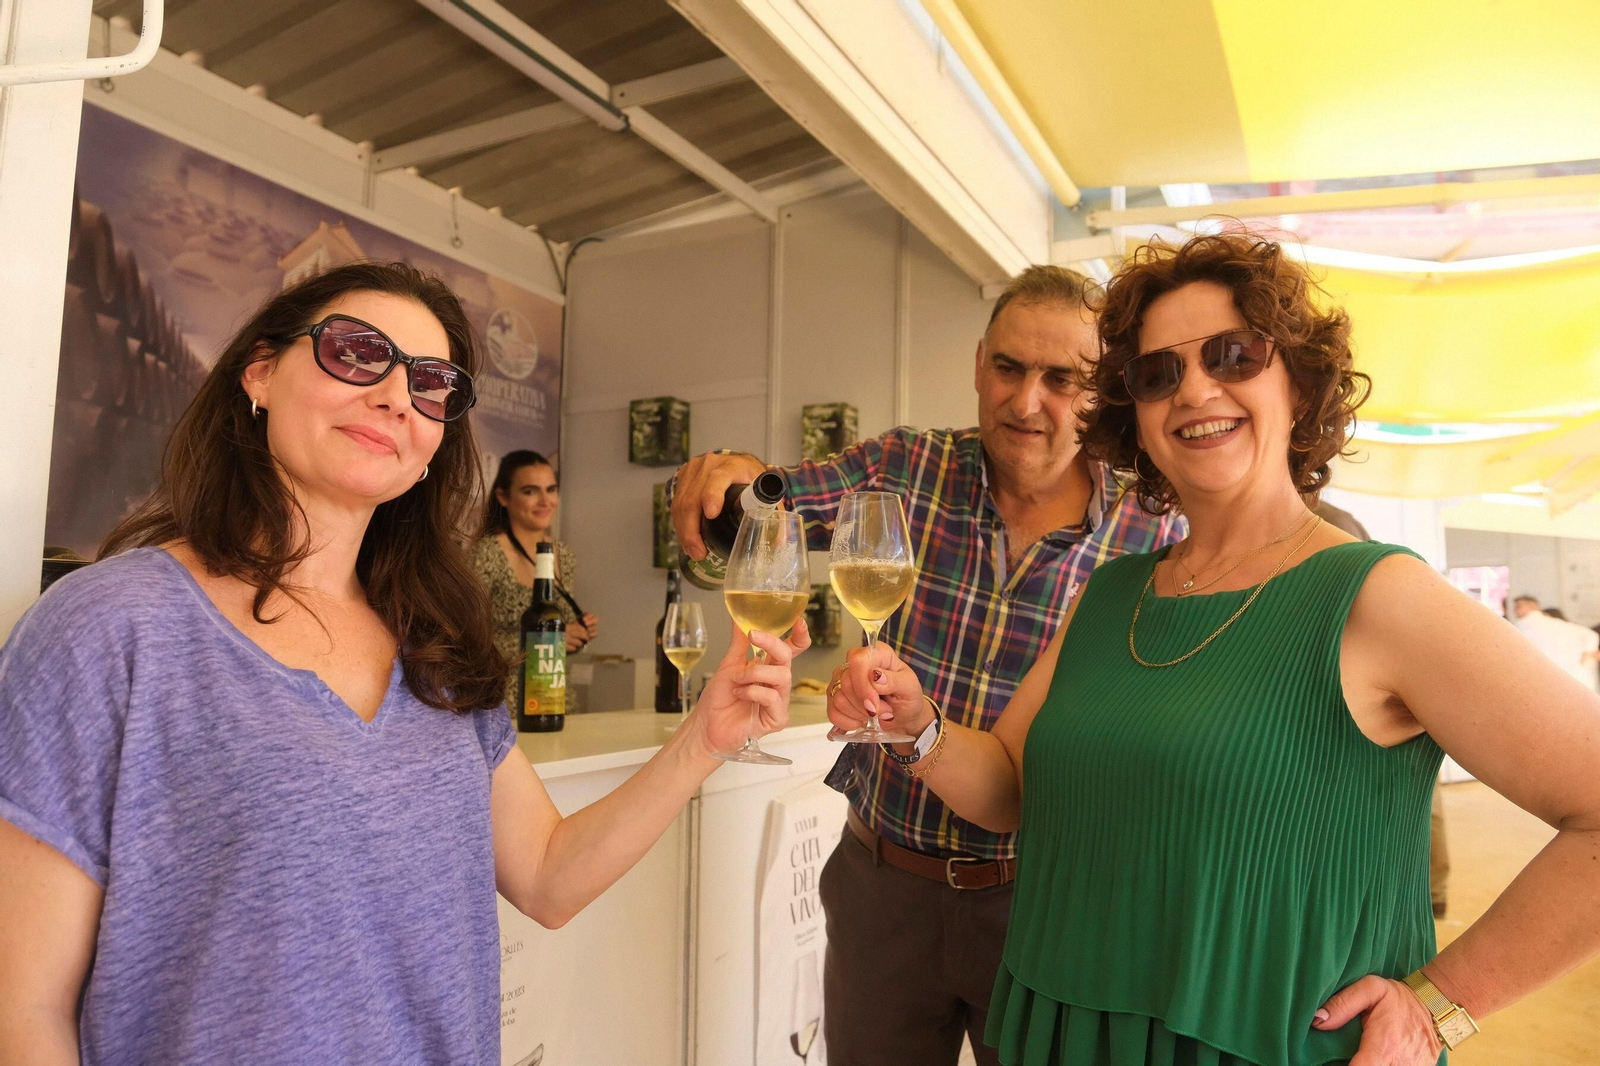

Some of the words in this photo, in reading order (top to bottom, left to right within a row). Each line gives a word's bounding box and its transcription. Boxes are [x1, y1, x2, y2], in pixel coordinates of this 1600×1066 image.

[534, 644, 554, 659] TI
[538, 659, 564, 674] NA
[549, 673, 566, 689] JA
[793, 866, 819, 896] DEL
[505, 985, 525, 1002] 2023
